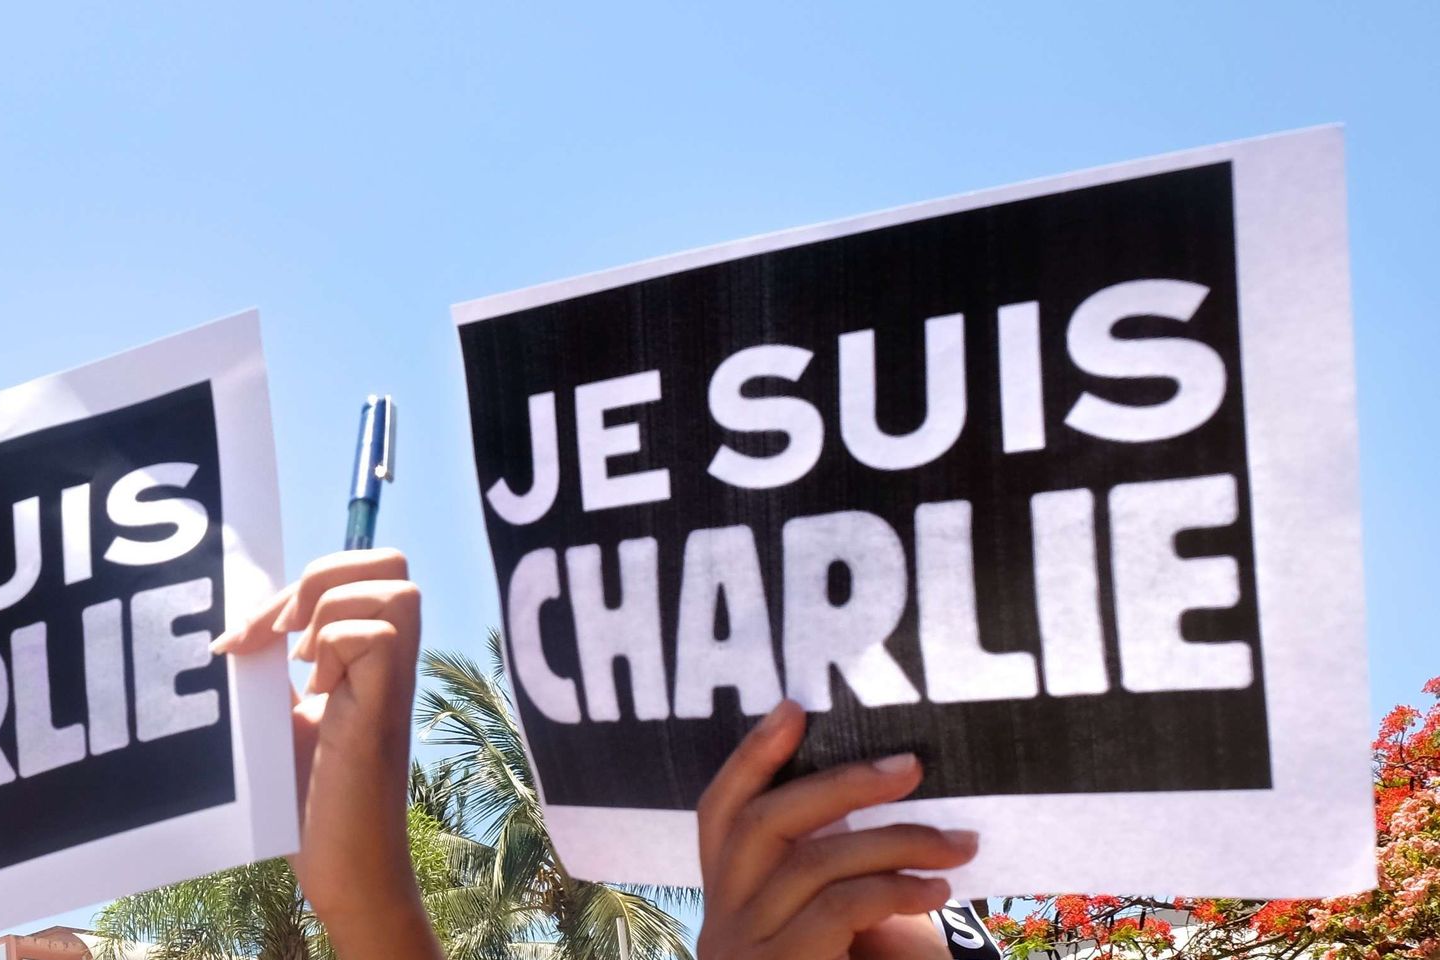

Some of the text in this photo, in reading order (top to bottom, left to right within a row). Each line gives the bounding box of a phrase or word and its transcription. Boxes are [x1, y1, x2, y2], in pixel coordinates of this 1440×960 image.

[486, 277, 1229, 527] JE SUIS
[506, 472, 1256, 726] CHARLIE
